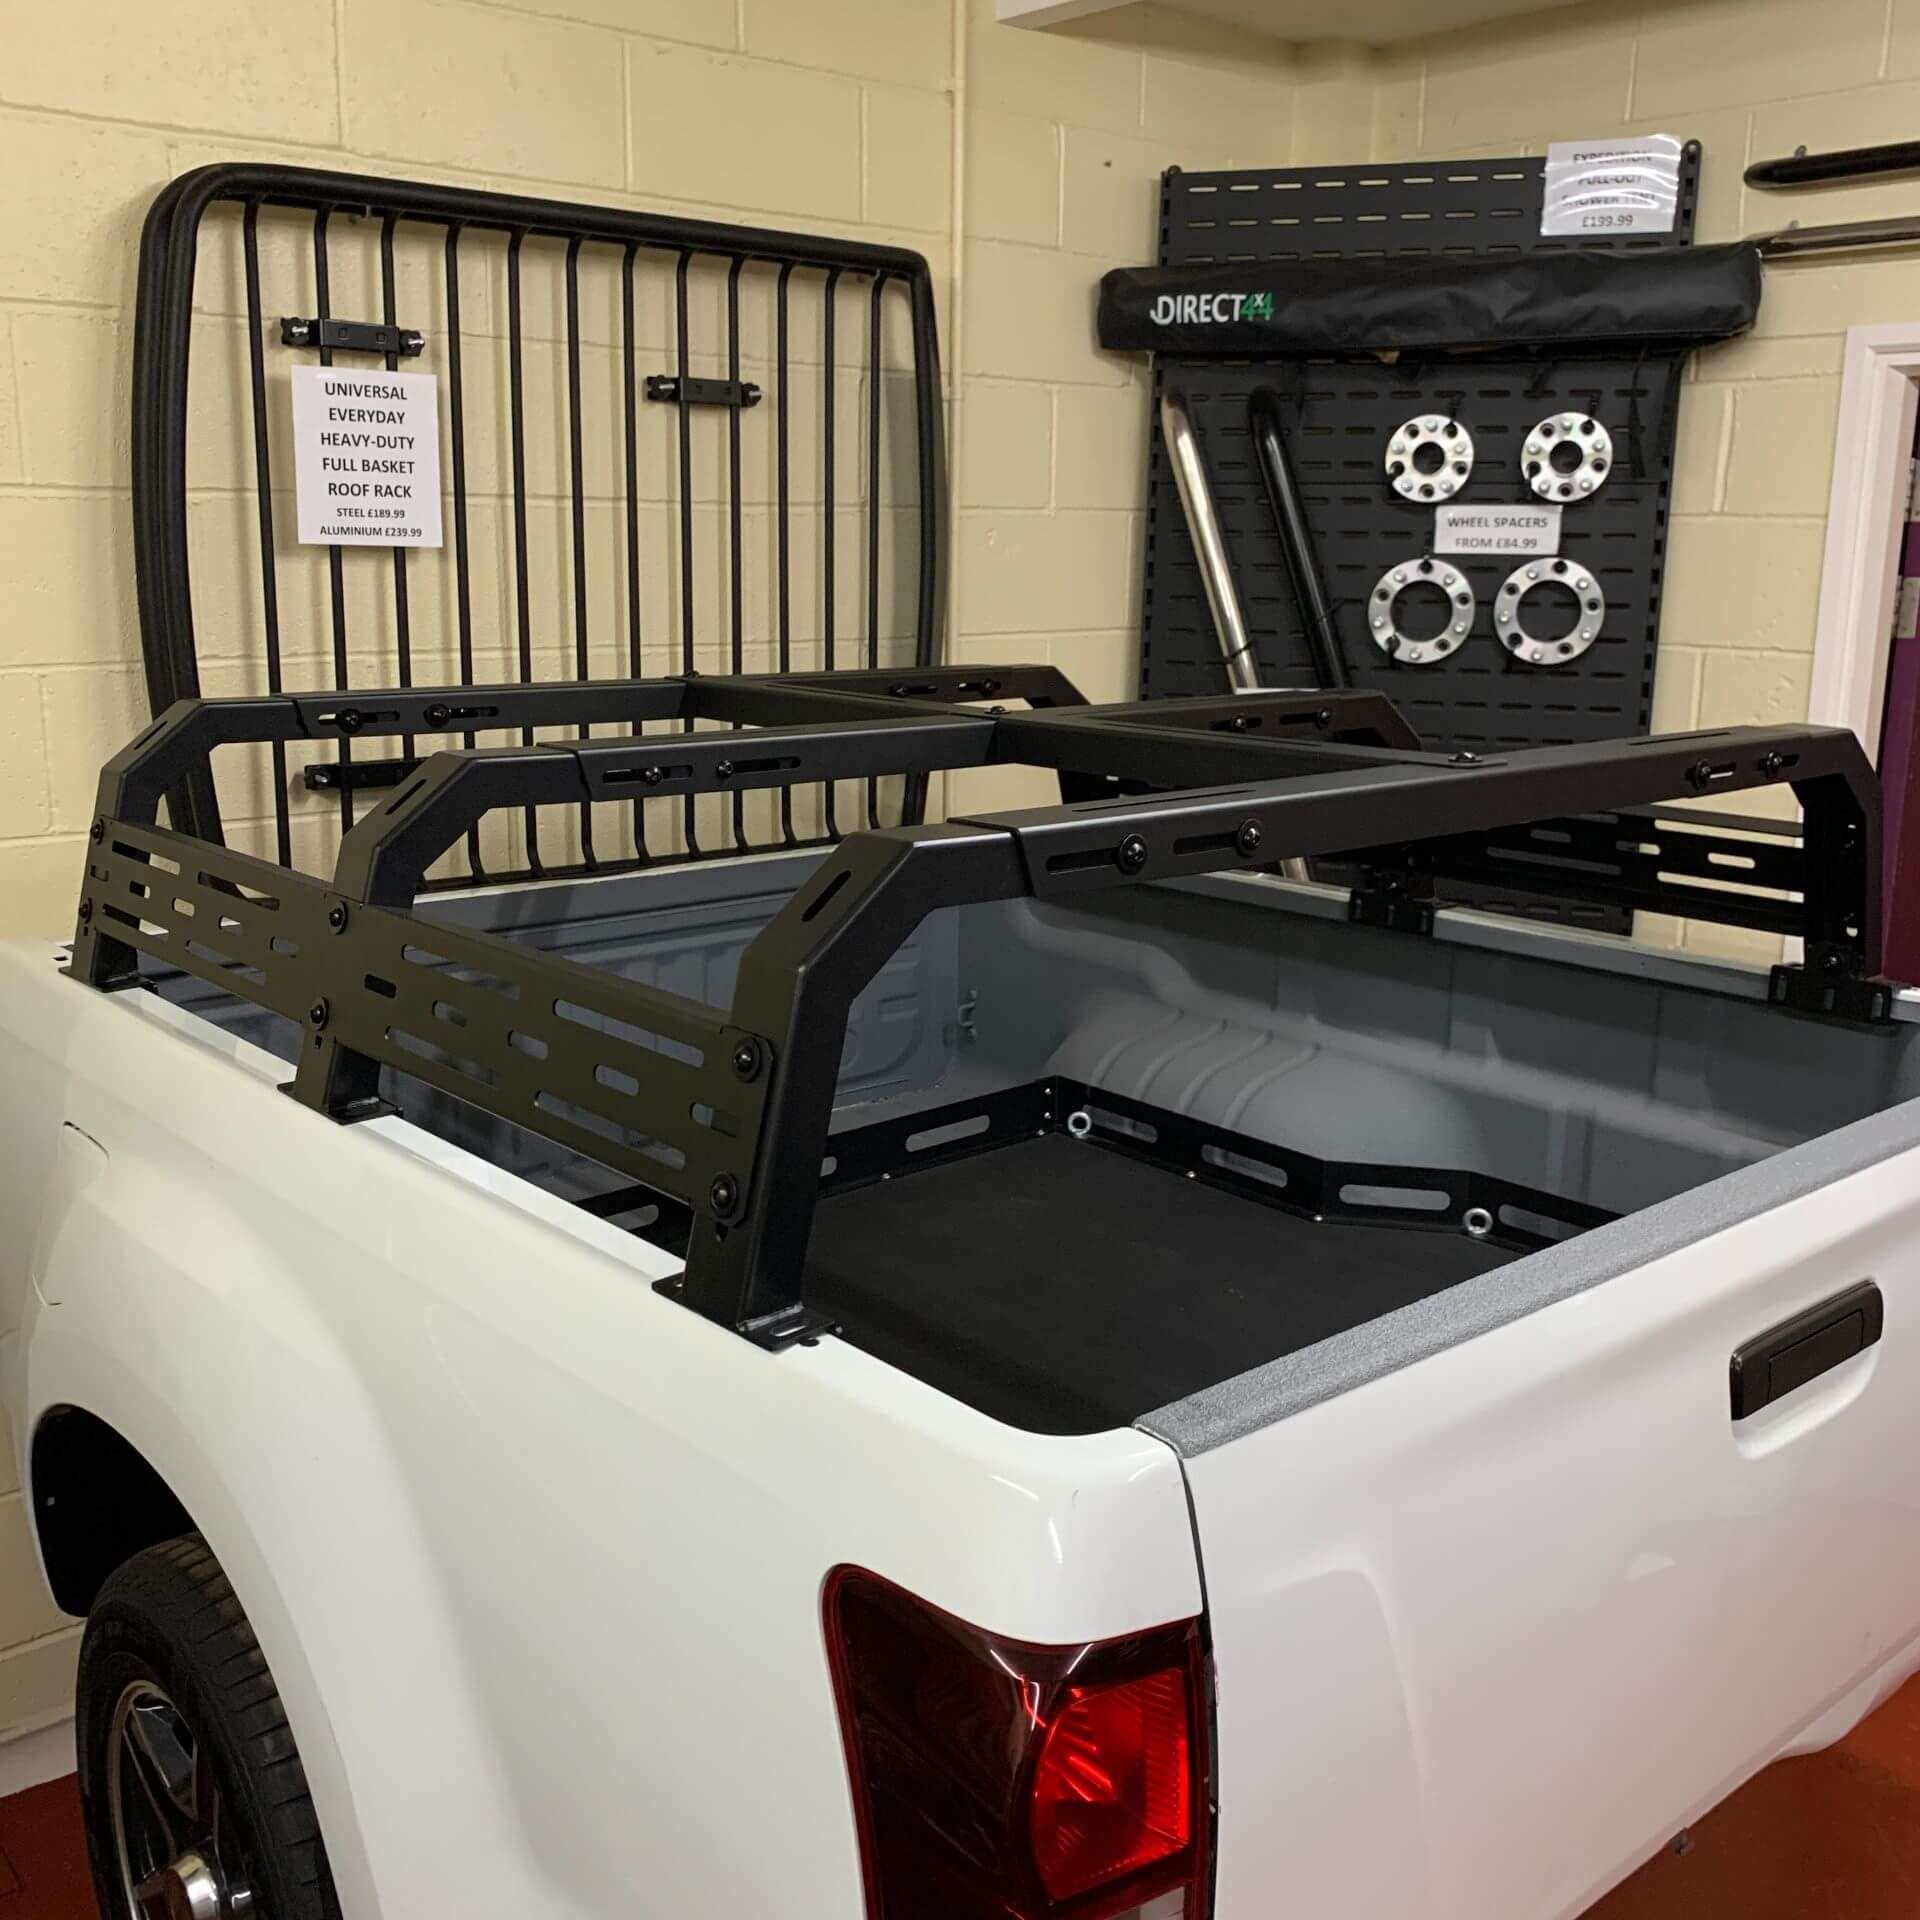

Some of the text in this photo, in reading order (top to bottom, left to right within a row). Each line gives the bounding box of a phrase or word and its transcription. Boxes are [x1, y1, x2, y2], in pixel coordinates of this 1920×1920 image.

[1582, 214, 1634, 228] £199.99
[324, 382, 408, 400] UNIVERSAL
[328, 407, 406, 425] EVERYDAY
[320, 432, 415, 450] HEAVY-DUTY
[322, 457, 415, 474] FULL BASKET
[328, 482, 412, 498] ROOF RACK
[336, 507, 405, 519] STEEL £189.99
[1447, 517, 1549, 528] WHEEL SPACERS
[319, 525, 422, 538] ALUMINIUM £239.99
[1455, 537, 1538, 549] FROM £84.99
